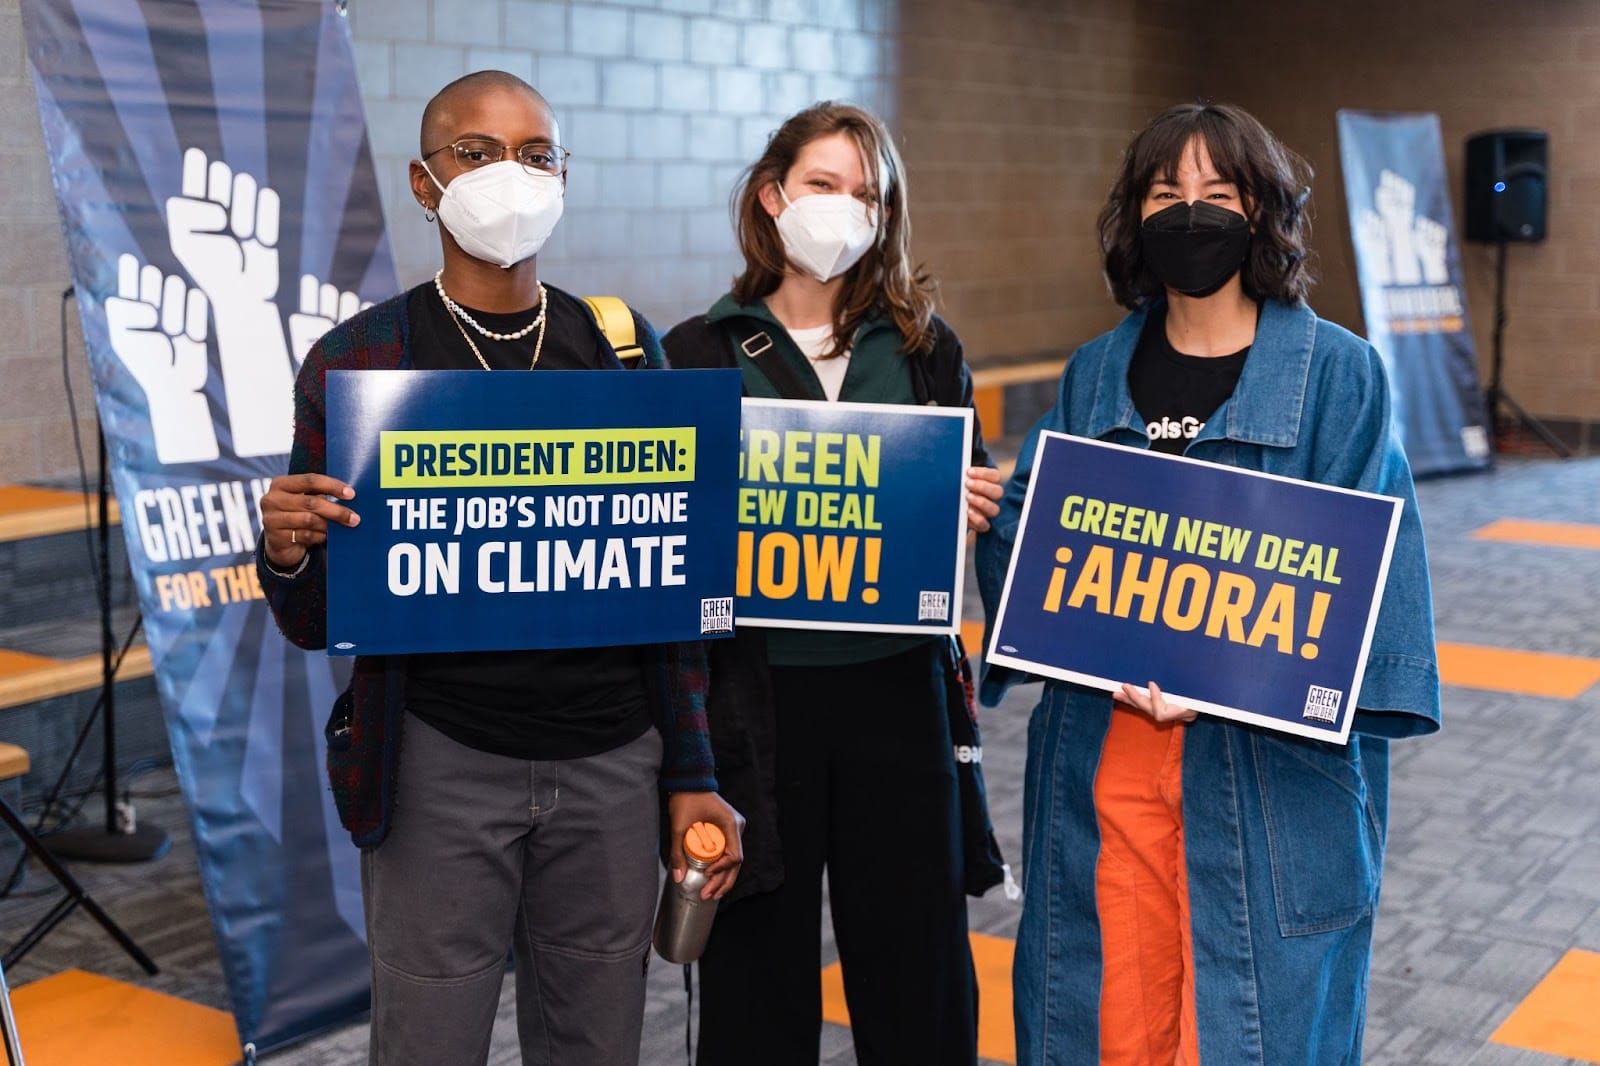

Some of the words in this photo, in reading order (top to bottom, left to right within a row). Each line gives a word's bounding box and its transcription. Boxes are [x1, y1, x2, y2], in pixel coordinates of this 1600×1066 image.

[1145, 416, 1206, 440] oisG
[394, 441, 575, 478] PRESIDENT
[583, 439, 688, 475] BIDEN:
[739, 429, 882, 489] REEN
[135, 480, 258, 563] GREEN
[386, 497, 447, 531] THE
[453, 495, 537, 536] JOB'S
[544, 494, 605, 528] NOT
[611, 491, 689, 526] DONE
[737, 487, 788, 526] EW
[795, 490, 883, 531] DEAL
[1060, 495, 1169, 548] GREEN
[1173, 516, 1253, 564] NEW
[1254, 533, 1342, 585] DEAL
[387, 541, 460, 597] ON
[477, 534, 688, 594] CLIMATE
[155, 571, 212, 613] FOR
[209, 563, 267, 605] THE
[703, 599, 731, 618] GREEN
[921, 592, 948, 608] GREEN
[1042, 544, 1333, 660] ¡AHORA!
[703, 618, 716, 630] NEW
[717, 617, 731, 629] DEAL
[1309, 687, 1340, 709] GREEN
